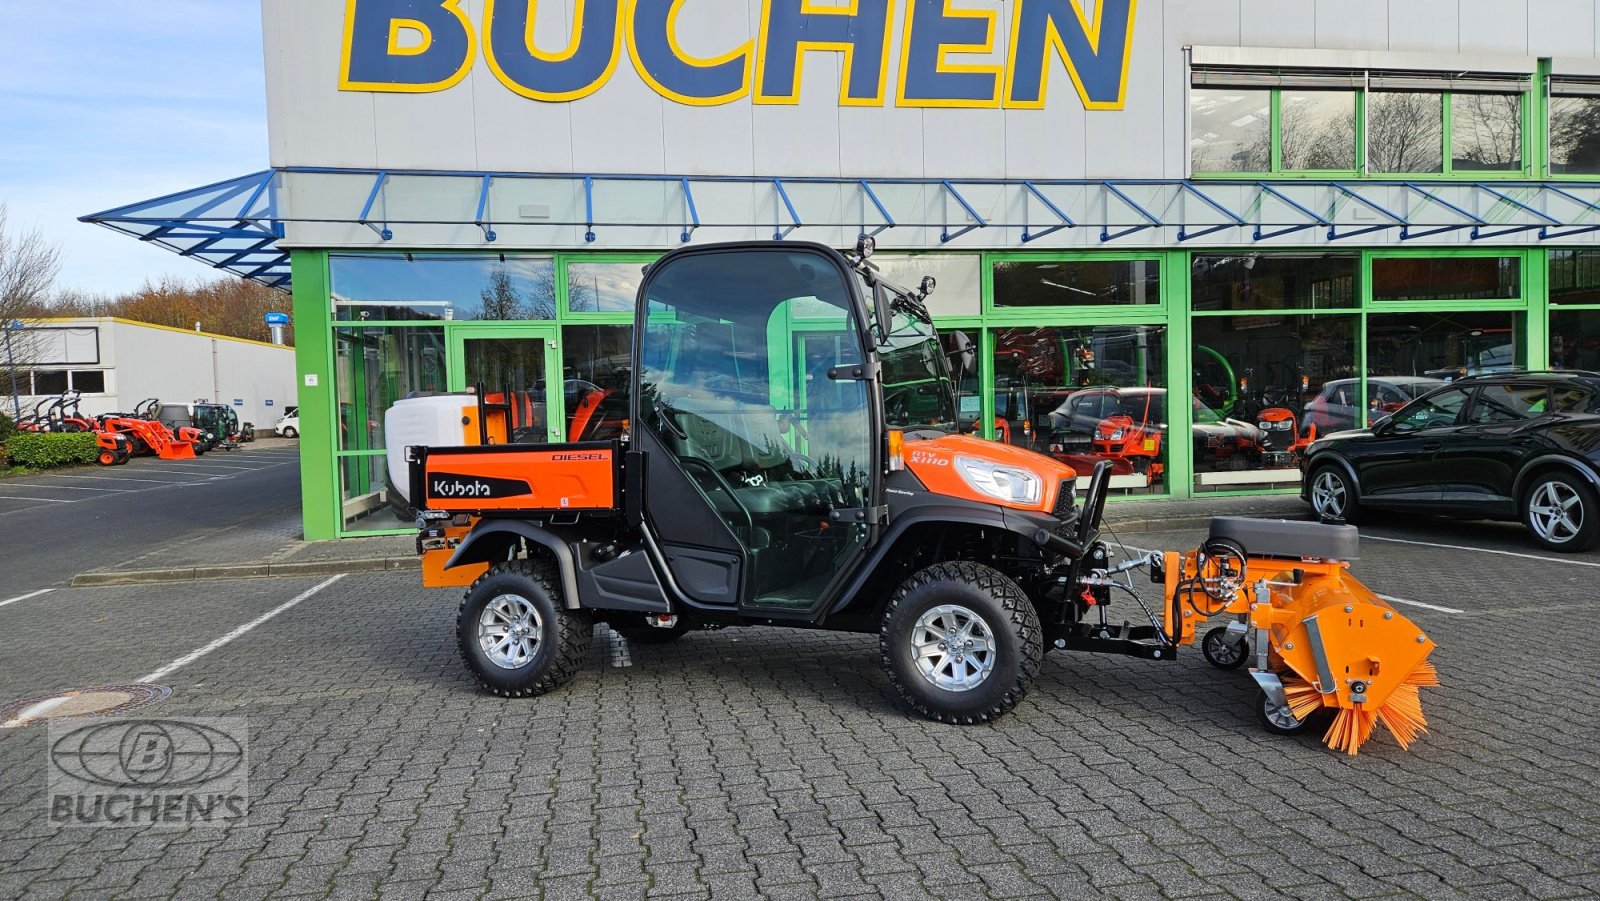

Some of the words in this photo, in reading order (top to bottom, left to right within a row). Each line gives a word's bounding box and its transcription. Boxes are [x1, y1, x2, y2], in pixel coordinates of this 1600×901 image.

[338, 0, 1138, 110] BUCHEN
[551, 453, 609, 461] DIESEL
[911, 450, 936, 459] RTV
[911, 456, 949, 466] X1110
[434, 480, 491, 496] Kubota
